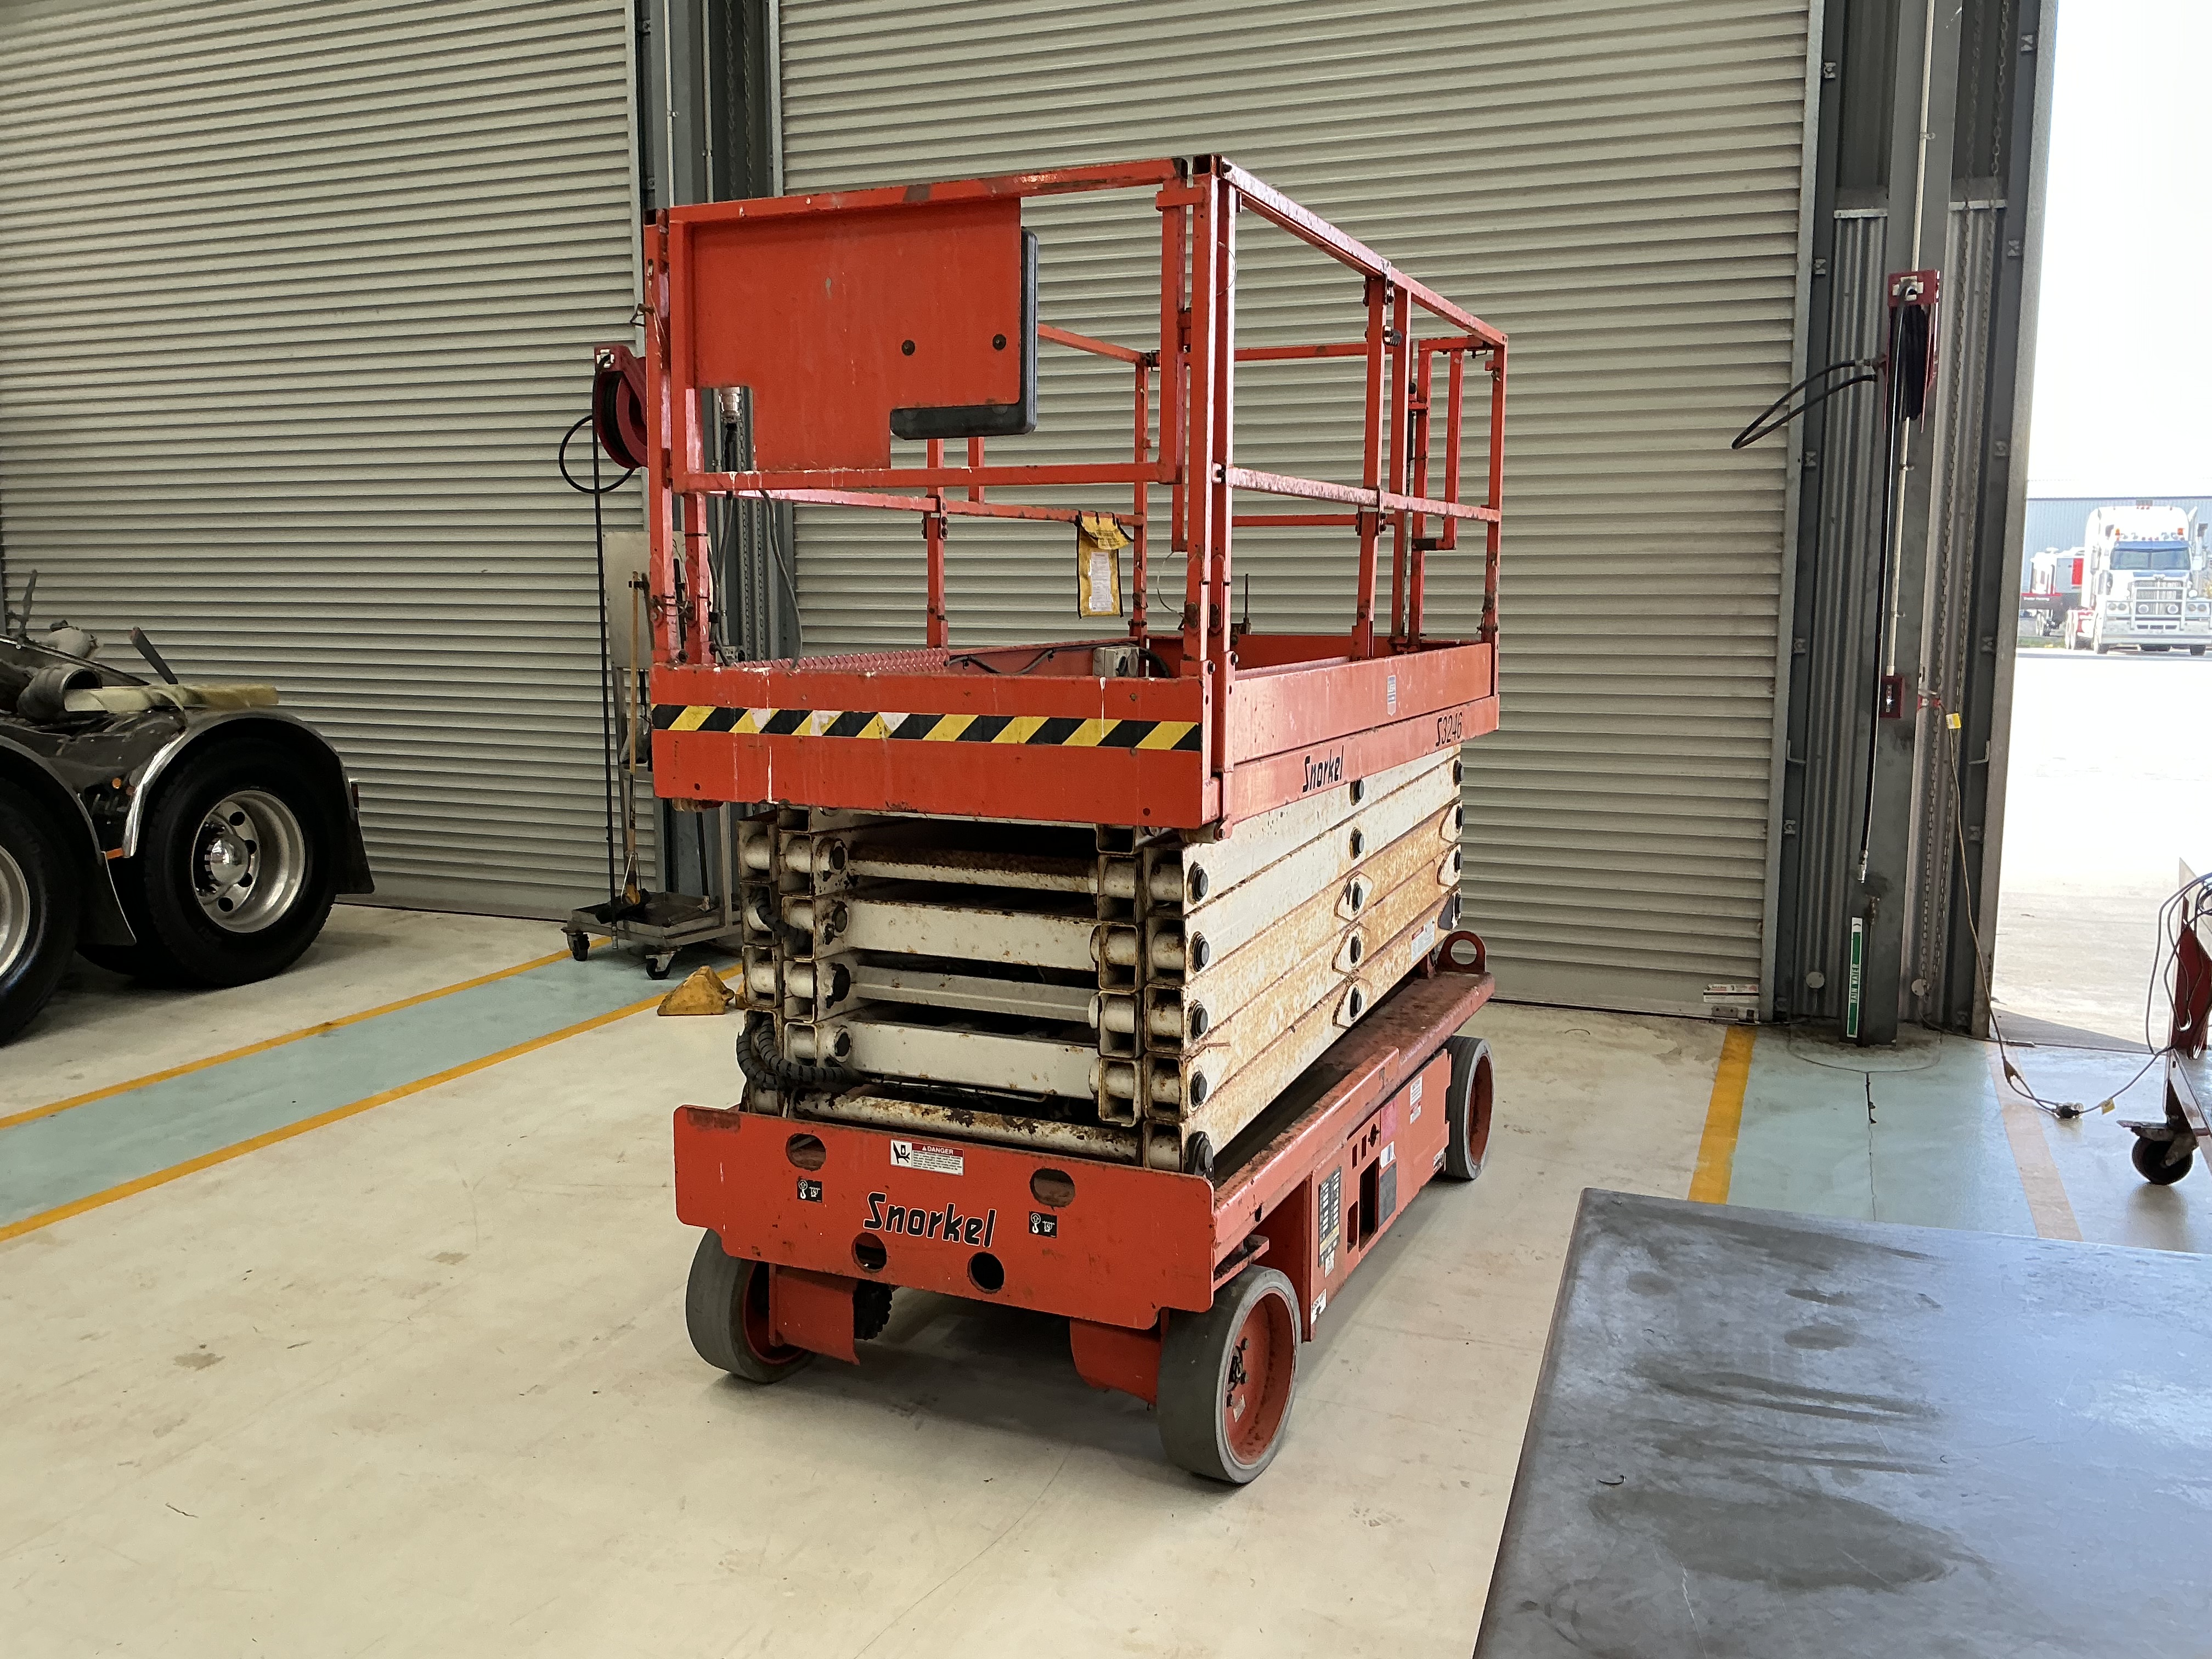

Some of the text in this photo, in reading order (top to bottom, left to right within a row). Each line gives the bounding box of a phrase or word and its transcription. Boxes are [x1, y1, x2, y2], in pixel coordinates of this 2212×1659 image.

[1435, 712, 1463, 747] S3246
[1302, 745, 1344, 793] Snorkel
[927, 1146, 954, 1155] DANGER
[863, 1192, 997, 1248] Snorkel
